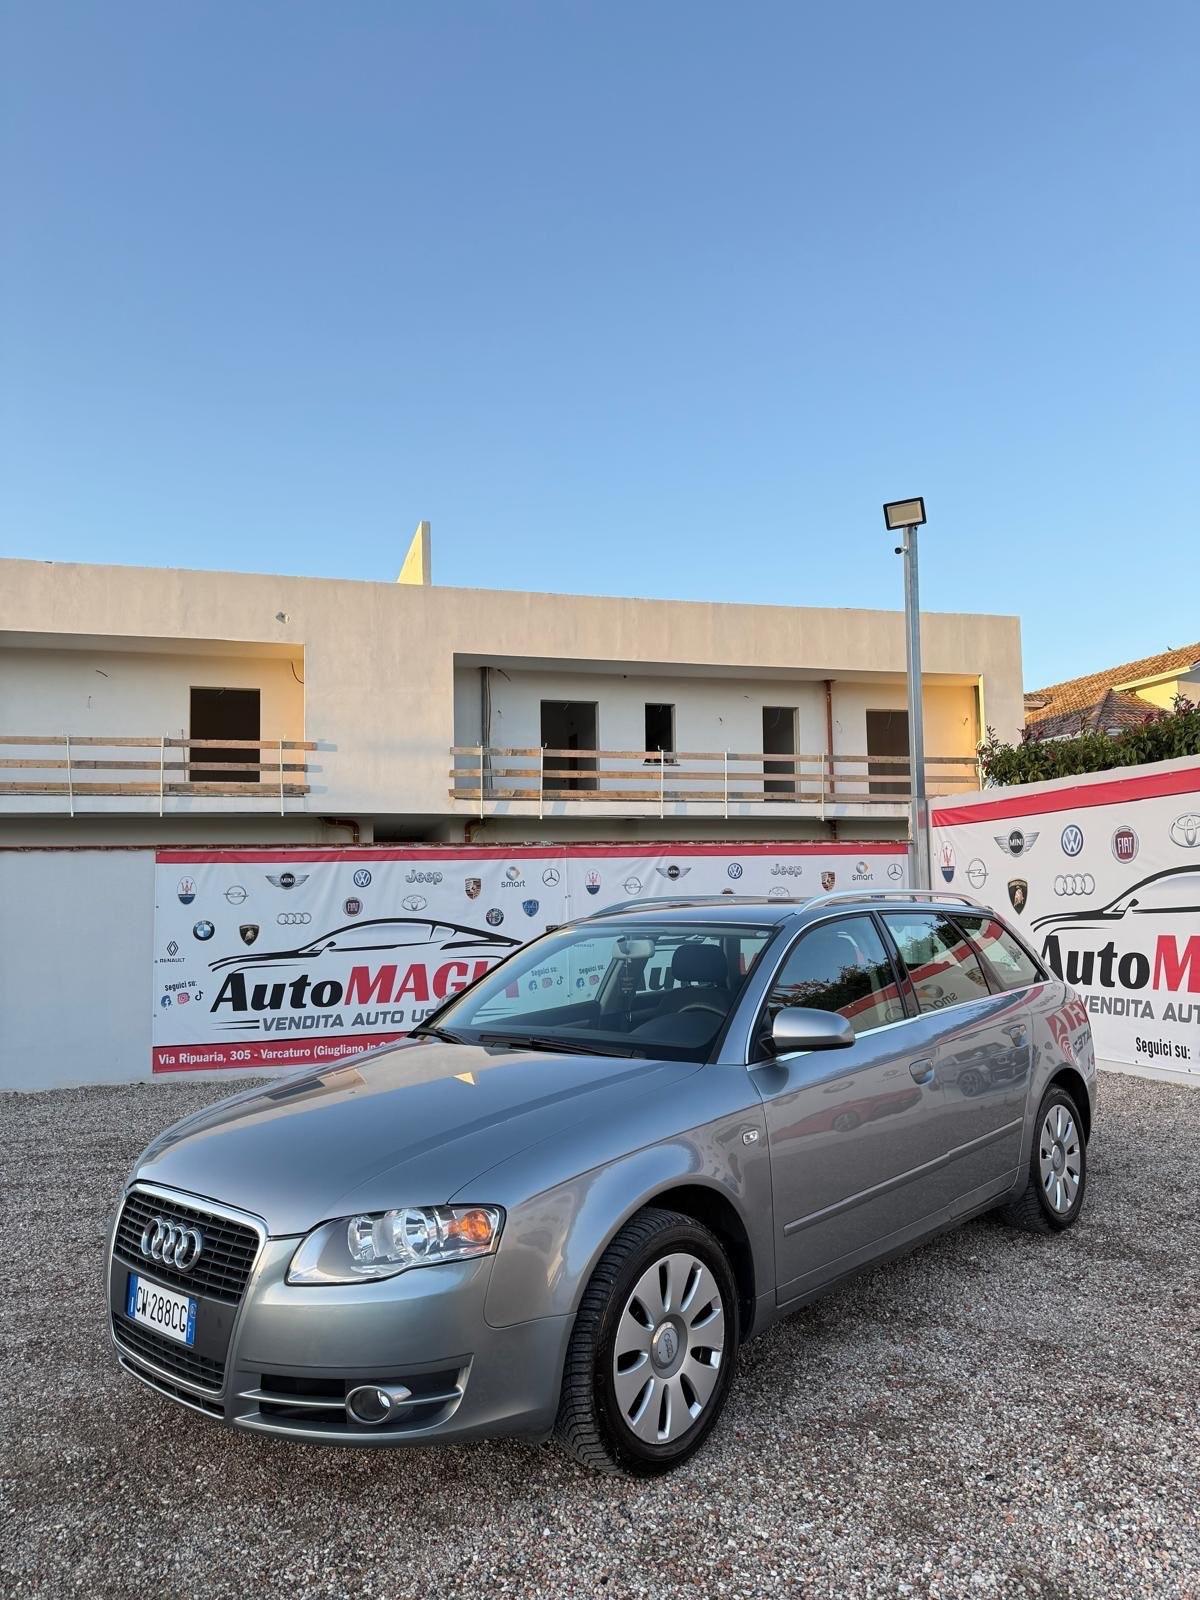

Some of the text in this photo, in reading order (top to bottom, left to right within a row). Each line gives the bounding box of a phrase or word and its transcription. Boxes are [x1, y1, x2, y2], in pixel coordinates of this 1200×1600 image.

[1009, 838, 1024, 847] MINI
[1117, 837, 1133, 854] FIAT
[405, 869, 444, 885] Jeep
[771, 864, 802, 877] Jeep
[852, 873, 873, 881] smart
[501, 880, 526, 888] smart
[262, 1013, 344, 1031] VENDITA
[351, 1009, 404, 1027] AUTO
[158, 1054, 175, 1065] Via
[179, 1052, 226, 1065] Ripuaria,
[230, 1050, 251, 1060] 305
[260, 1047, 311, 1059] Varcaturo
[313, 1043, 364, 1058] (Giugliano
[1136, 1037, 1191, 1060] Seguici su:
